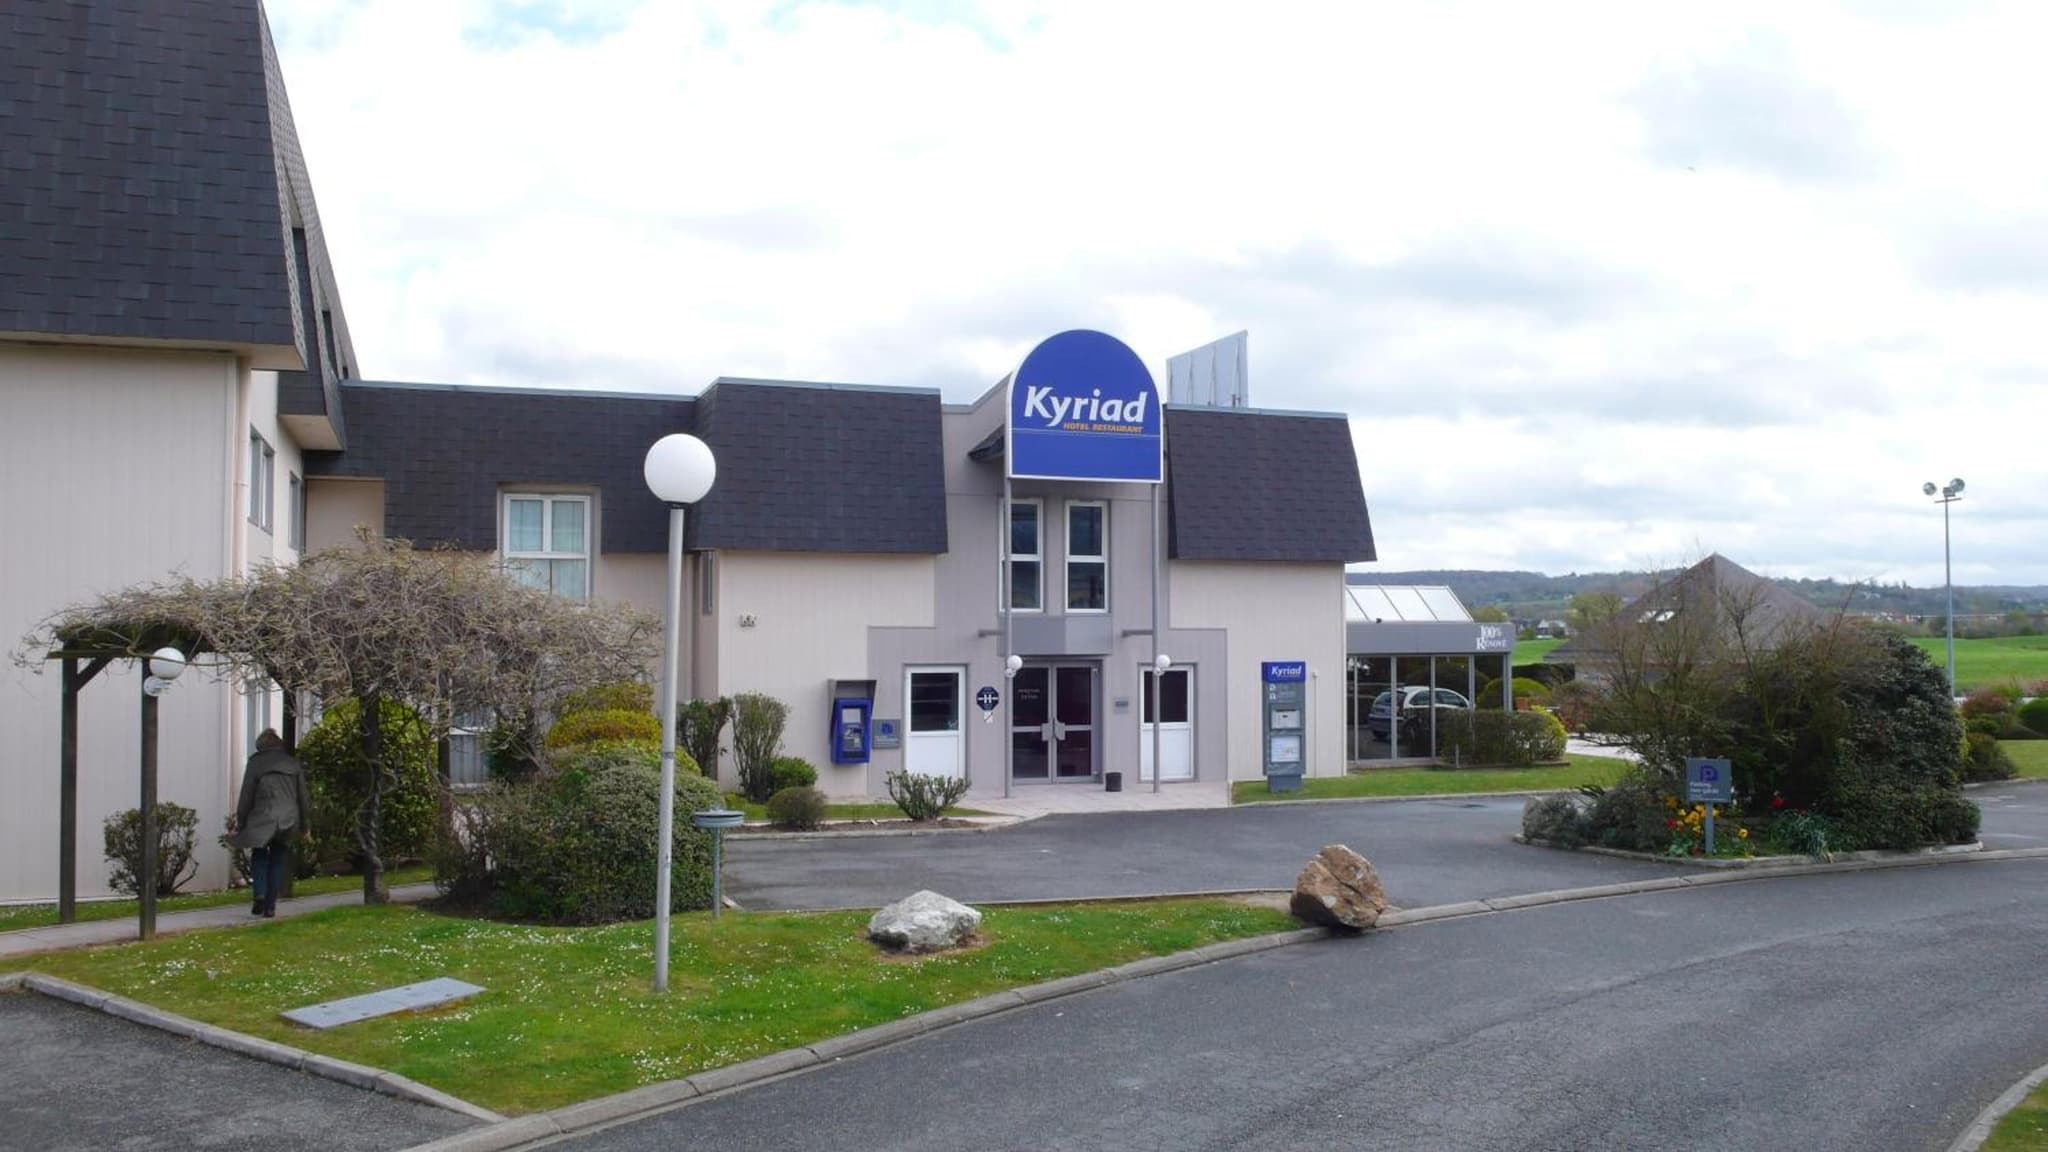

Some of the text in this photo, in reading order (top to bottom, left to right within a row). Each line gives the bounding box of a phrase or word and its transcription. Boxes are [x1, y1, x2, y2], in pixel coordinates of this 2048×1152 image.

[1024, 385, 1148, 427] Kyriad
[1063, 422, 1144, 433] HOTEL RESTAURANT
[1271, 665, 1302, 678] Kyriad
